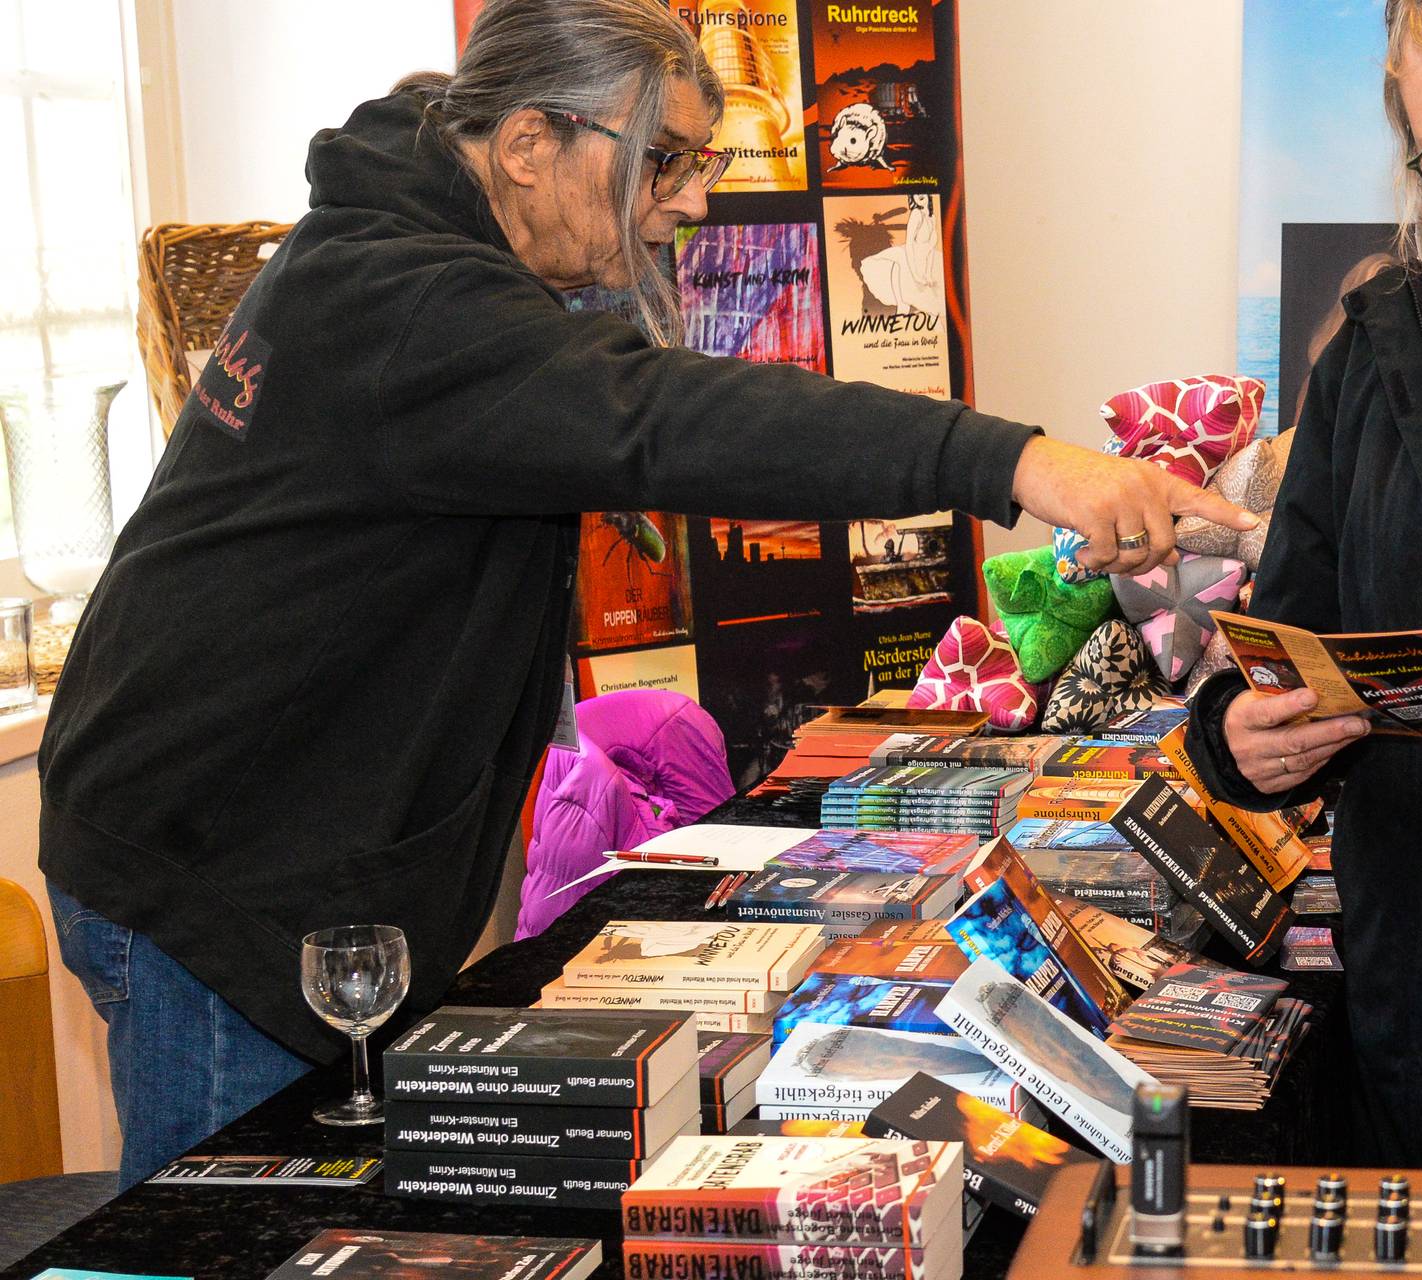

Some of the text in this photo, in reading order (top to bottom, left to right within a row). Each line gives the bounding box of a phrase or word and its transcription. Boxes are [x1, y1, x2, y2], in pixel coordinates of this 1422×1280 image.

[678, 8, 787, 29] Ruhrspione
[827, 5, 919, 24] Ruhrdreck
[724, 147, 798, 159] Wittenfeld
[692, 271, 743, 290] KUNST
[771, 267, 811, 288] KRIMI
[841, 309, 940, 336] WINNETOU
[863, 340, 879, 349] und
[880, 339, 893, 348] die
[911, 337, 920, 346] in
[600, 674, 678, 693] Christiane Bogenstahl
[878, 671, 893, 682] an
[896, 668, 912, 680] der
[907, 760, 948, 769] Todesfolge
[1073, 771, 1129, 780] Ruhrdreck
[973, 789, 998, 797] Henning
[968, 799, 992, 807] Henning
[966, 818, 990, 826] Henning
[967, 809, 991, 817] Henning
[1033, 809, 1100, 821] Ruhrspione
[967, 828, 992, 836] Henning
[1122, 816, 1197, 889] MAUERZWILLINGE
[1228, 816, 1275, 873] Uwe Wittenfeld
[1074, 889, 1149, 898] Uwe Wittenfeld
[737, 906, 826, 919] Ausmanövriert
[831, 910, 871, 920] Gassler
[1130, 917, 1153, 926] Uwe
[1198, 891, 1256, 950] Uwe Wittenfeld
[694, 925, 741, 966] WINNETOU
[895, 946, 932, 972] HARPER
[622, 973, 664, 984] WINNETOU
[1025, 957, 1060, 995] HARPER
[600, 996, 642, 1007] WINNETOU
[719, 998, 736, 1006] Martina
[869, 986, 911, 1017] HARPER
[1137, 1002, 1246, 1027] Krimiprogramm
[428, 1031, 464, 1052] Zimmer
[459, 1037, 482, 1052] ohne
[428, 1063, 518, 1077] Ein Münster-Krimi
[395, 1076, 634, 1096] Gunnar Beuth Zimmer ohne Wiederkehr
[952, 1012, 1133, 1163] alter Kuhnke Leiche tiefgekühlt
[774, 1084, 1007, 1107] Walte che tiefgekühlt
[430, 1114, 518, 1128] Ein Münster-Krimi
[398, 1128, 632, 1147] Gunnar Beuth Zimmer ohne Wiederkehr
[429, 1165, 516, 1178] Ein Münster-Krimi
[699, 1141, 762, 1191] DATENGRAB
[397, 1179, 629, 1199] Gunnar Beuth Zimmer ohne Wiederkehr
[1014, 1198, 1040, 1216] nke
[628, 1205, 759, 1235] DATENGRAB
[628, 1253, 760, 1280] DATENGRAB
